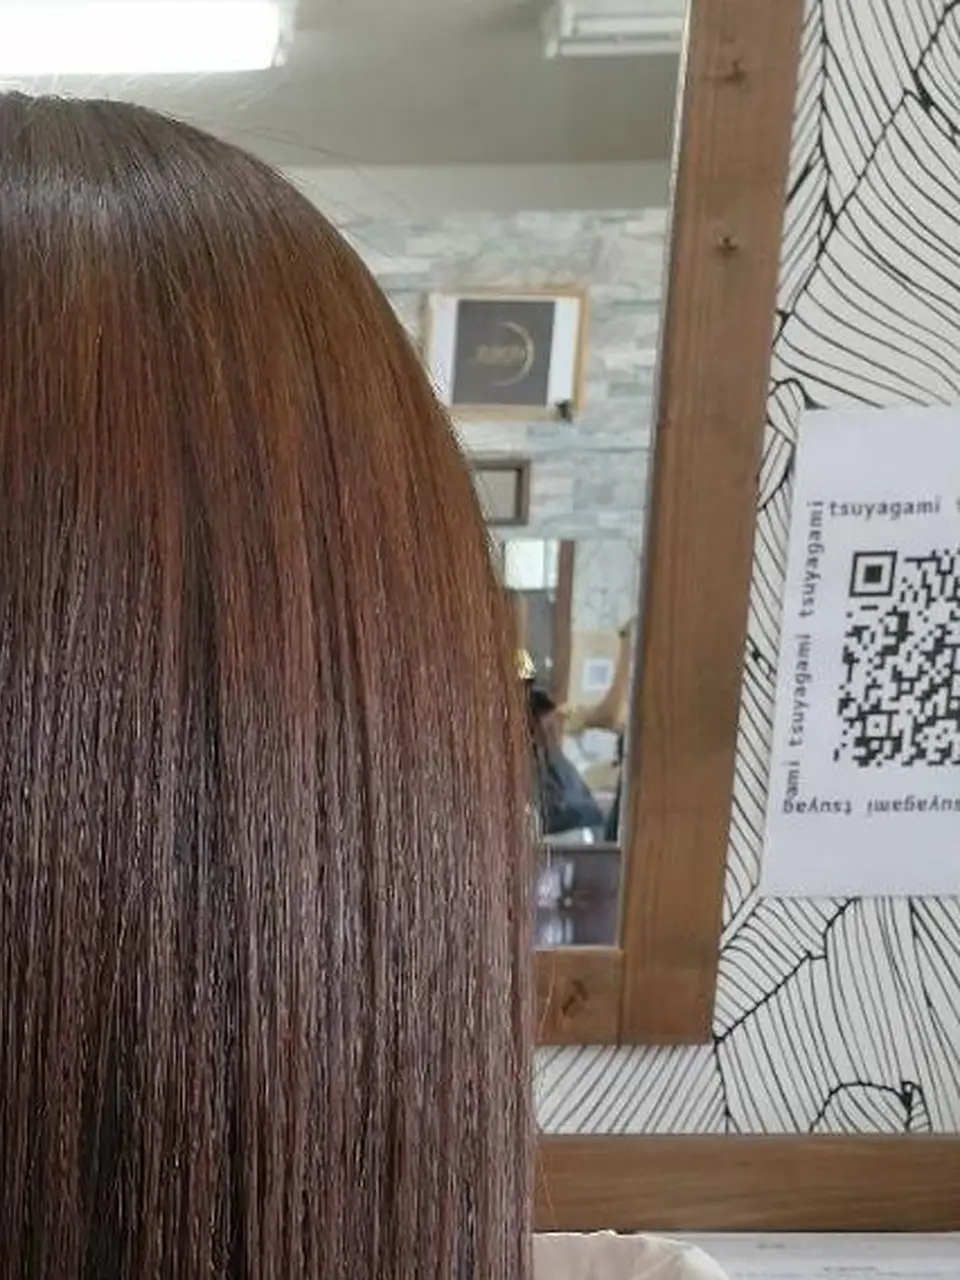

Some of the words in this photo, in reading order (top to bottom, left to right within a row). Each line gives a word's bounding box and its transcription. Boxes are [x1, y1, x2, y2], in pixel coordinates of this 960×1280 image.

[799, 500, 825, 618] tsuyagami
[829, 496, 941, 521] tsuyagami
[788, 634, 812, 746] tsuyagami
